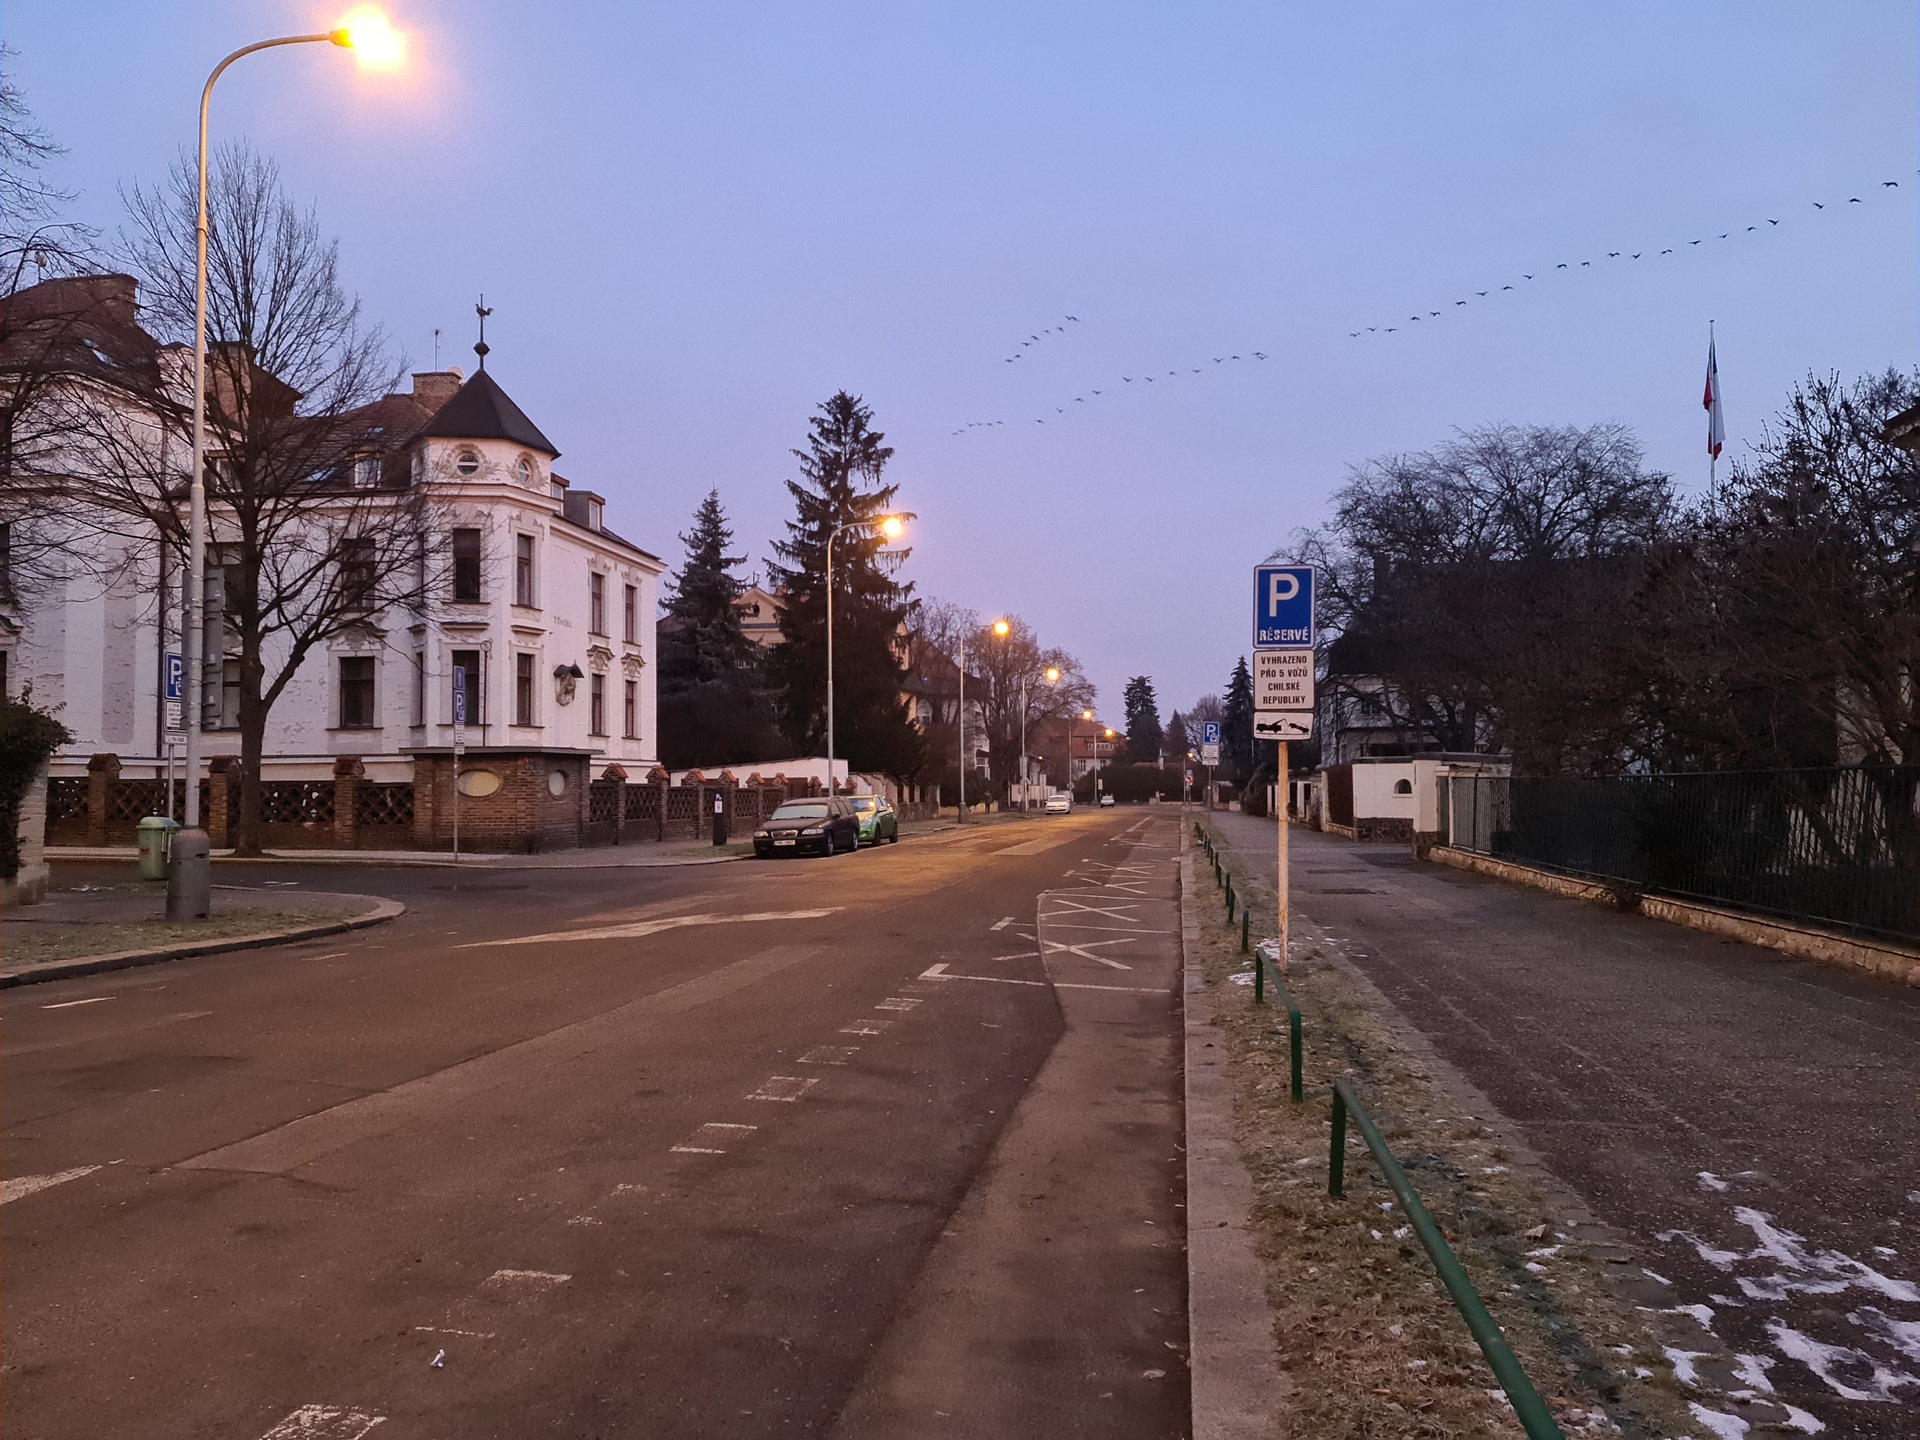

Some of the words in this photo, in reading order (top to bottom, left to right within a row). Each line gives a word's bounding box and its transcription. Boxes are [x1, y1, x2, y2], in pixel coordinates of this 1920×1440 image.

[1269, 573, 1299, 617] P
[1259, 627, 1309, 641] RÉSERVÉ
[1261, 655, 1307, 665] VYHRAZENO
[171, 659, 182, 684] P
[1279, 669, 1285, 678] 5
[1287, 666, 1308, 678] VOZŮ
[1268, 681, 1301, 691] CHILSKÉ
[456, 694, 463, 712] P
[1263, 696, 1306, 705] REPUBLIKY
[1206, 724, 1216, 737] P
